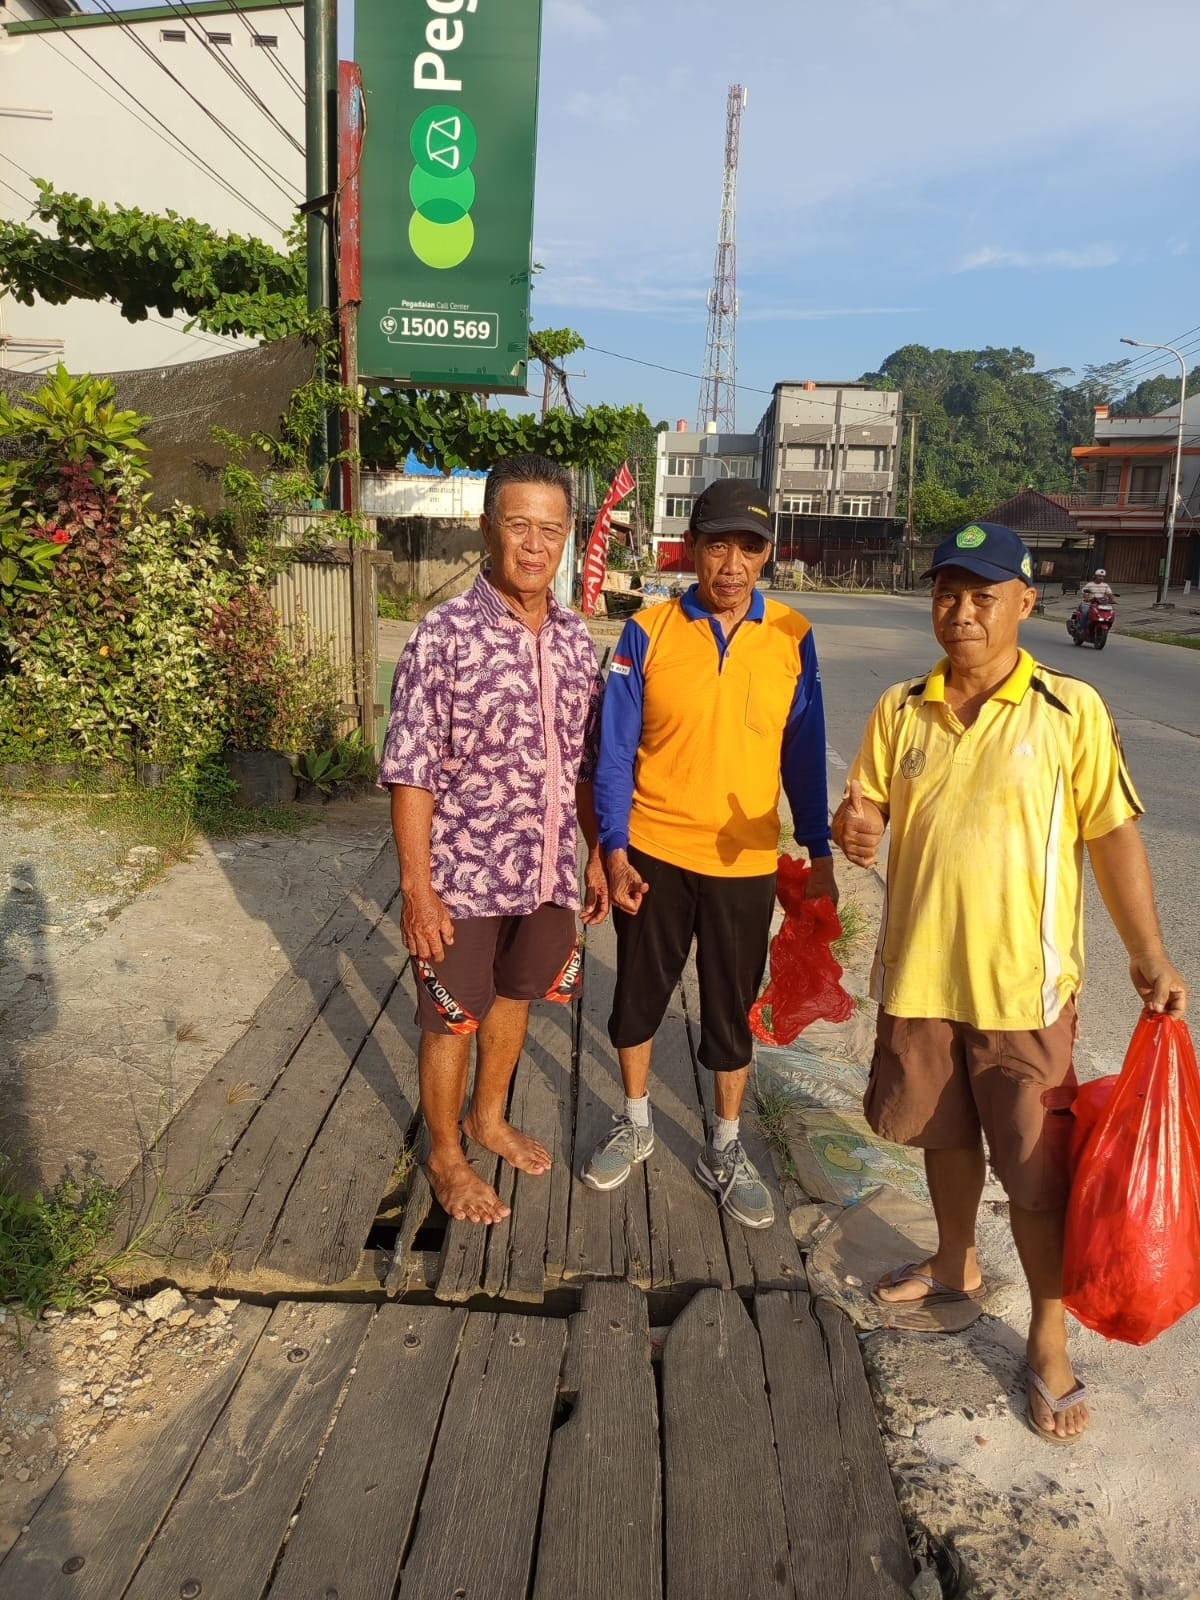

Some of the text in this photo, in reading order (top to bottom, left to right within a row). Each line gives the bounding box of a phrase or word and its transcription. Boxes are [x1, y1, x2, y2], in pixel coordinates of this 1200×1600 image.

[401, 300, 435, 309] Pegadaian
[450, 302, 470, 311] Center
[401, 317, 490, 340] 1500 569
[557, 951, 581, 989] YONEX
[431, 980, 463, 1019] YONEX
